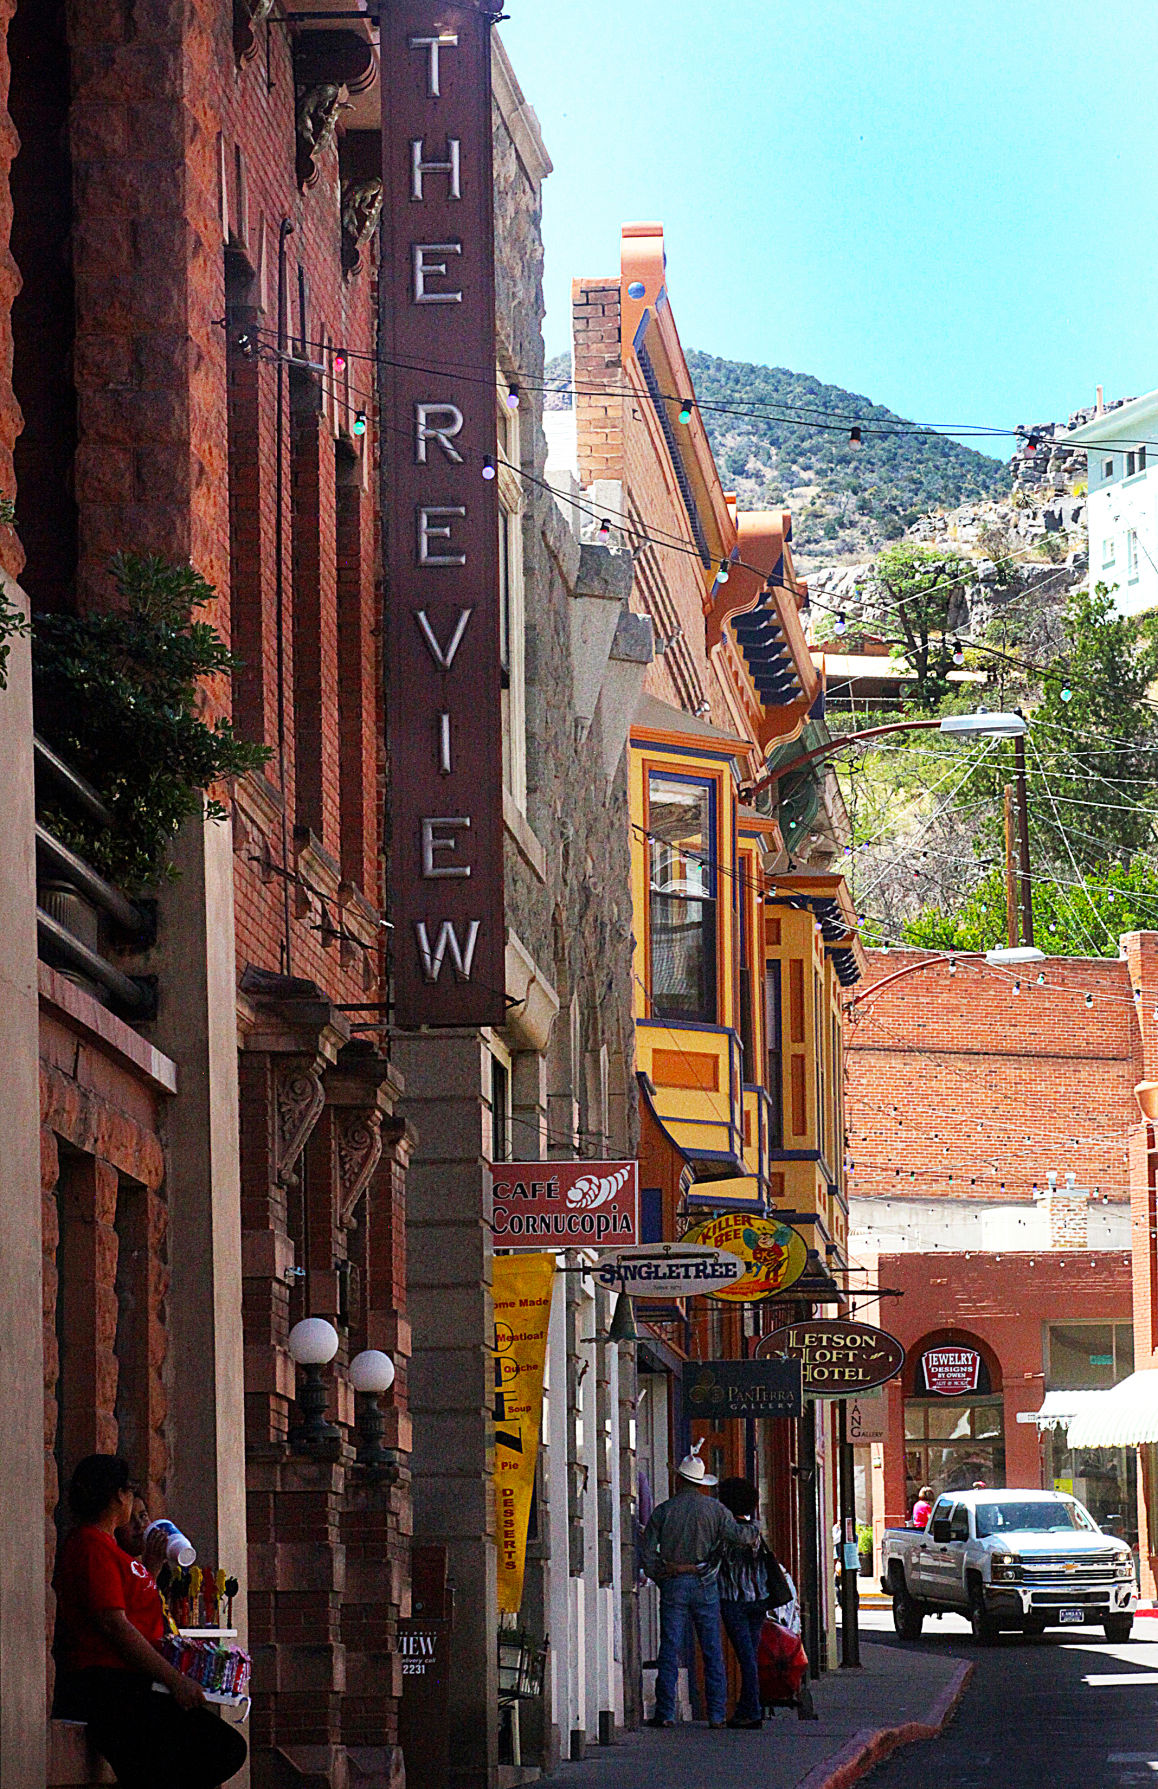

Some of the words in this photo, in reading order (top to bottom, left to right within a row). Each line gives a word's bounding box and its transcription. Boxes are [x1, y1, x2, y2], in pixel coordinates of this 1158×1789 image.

[409, 35, 462, 303] THE
[414, 403, 482, 983] REVIEW
[493, 1176, 560, 1199] CAFÉ
[701, 1214, 754, 1245] KILLER
[714, 1228, 742, 1248] BEE
[600, 1261, 737, 1285] SINGLETREE
[494, 1300, 515, 1310] ome
[519, 1298, 549, 1308] Made
[497, 1331, 544, 1343] Meatloaf
[788, 1330, 876, 1348] LETSON
[801, 1348, 858, 1364] LOFT
[928, 1353, 974, 1368] JEWELRY
[504, 1363, 538, 1374] Quiche
[728, 1386, 795, 1402] PANTERRA
[508, 1404, 531, 1415] Soup
[730, 1402, 793, 1410] GALLERY
[501, 1461, 519, 1470] Pie
[502, 1488, 516, 1570] DESSERTS
[402, 1664, 426, 1675] 2231
